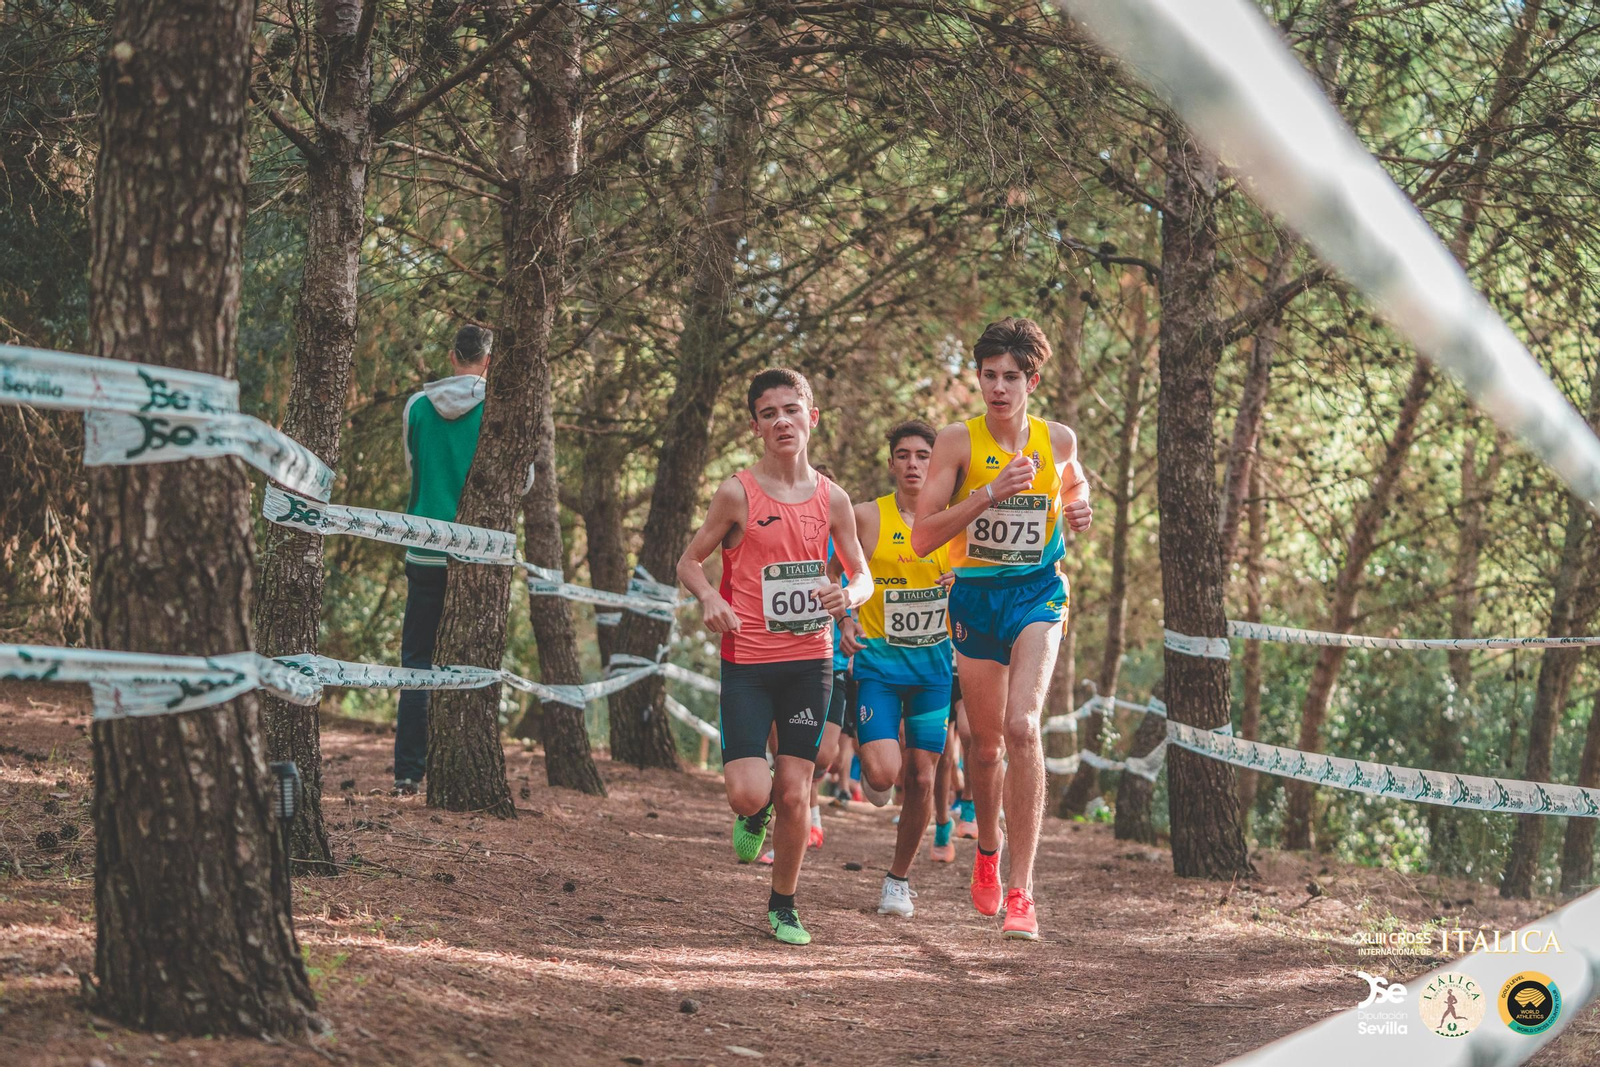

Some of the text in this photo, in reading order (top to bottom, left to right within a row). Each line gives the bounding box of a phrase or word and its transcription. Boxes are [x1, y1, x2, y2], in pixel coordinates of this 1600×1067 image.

[974, 518, 1040, 544] 8075
[786, 563, 819, 575] ITÁLICA
[772, 589, 826, 616] 605
[891, 608, 946, 632] 8077
[789, 717, 818, 727] adidas
